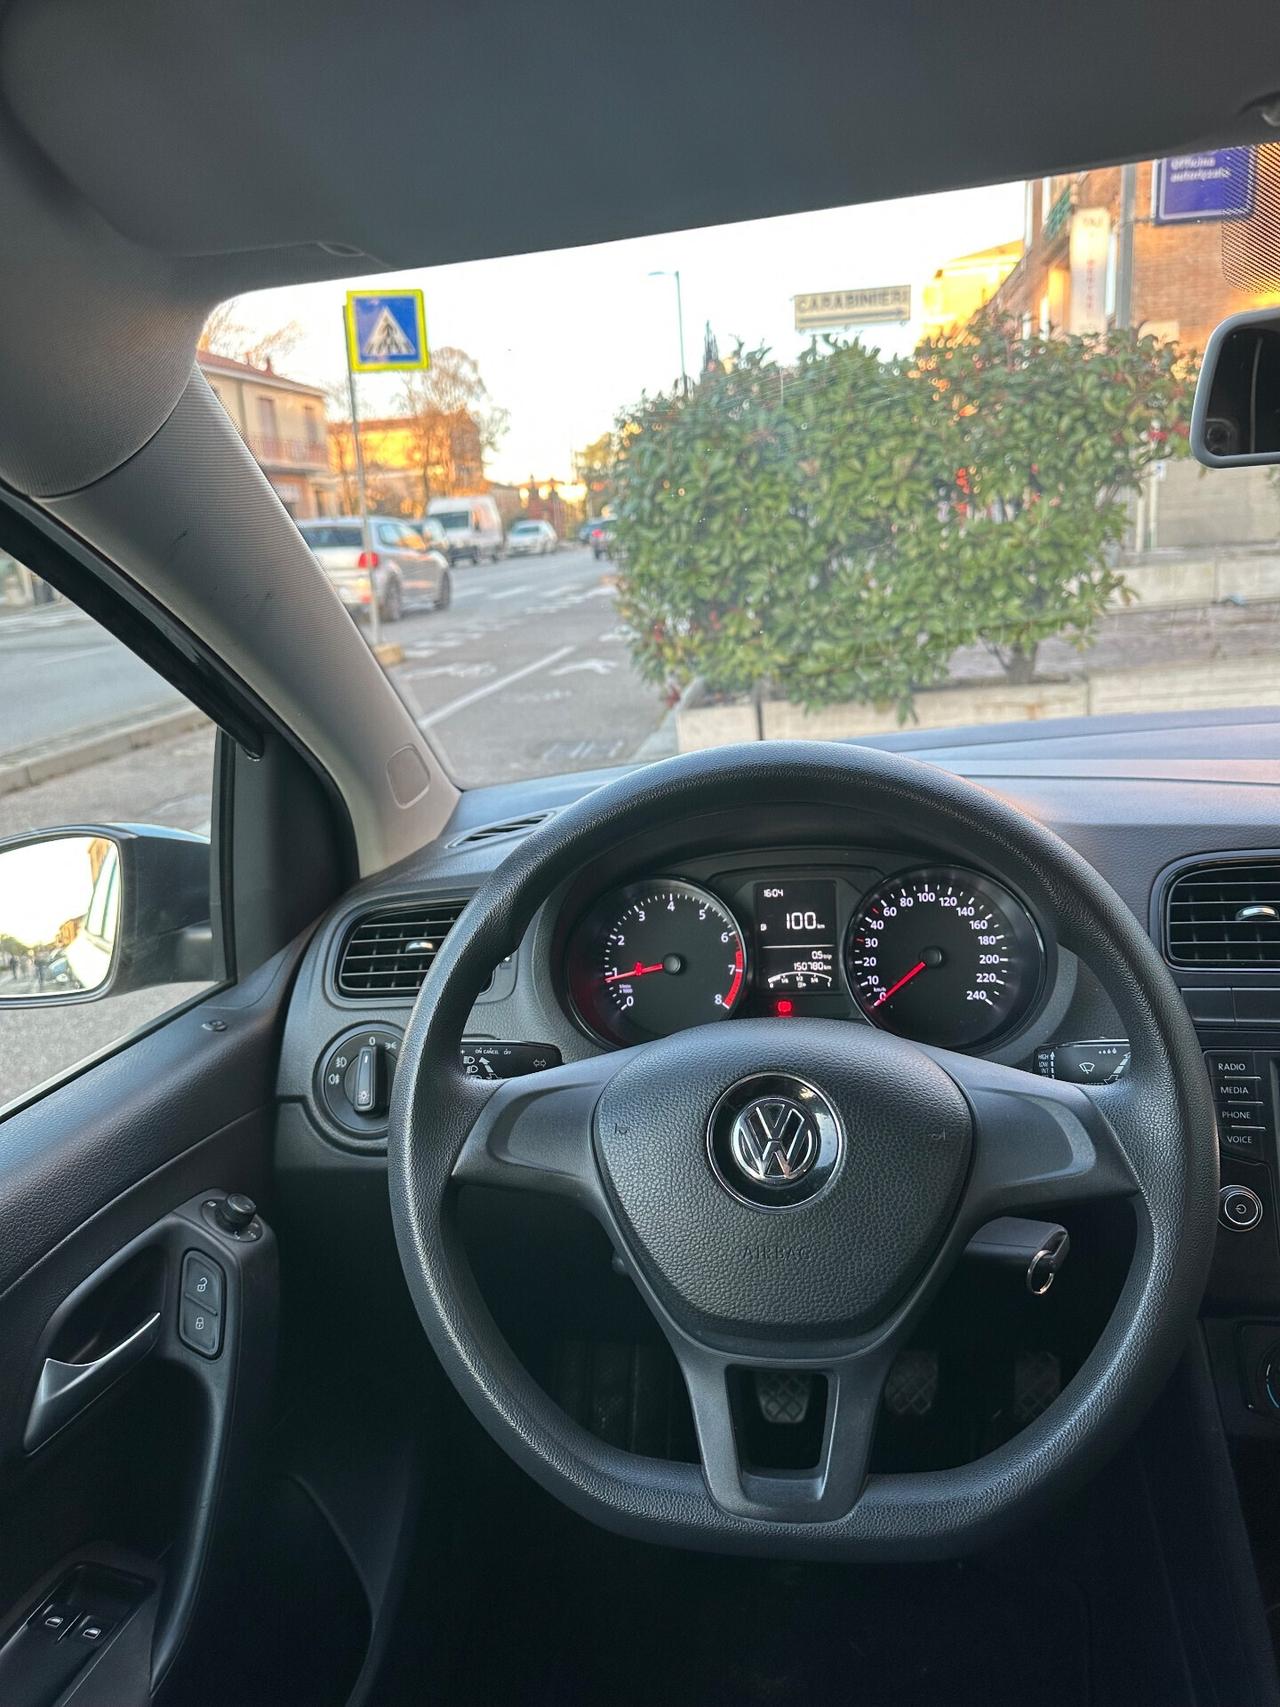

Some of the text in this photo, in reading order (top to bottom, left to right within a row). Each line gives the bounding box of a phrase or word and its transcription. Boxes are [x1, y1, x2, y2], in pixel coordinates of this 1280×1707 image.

[799, 289, 909, 313] CARABINIERI
[900, 897, 913, 907] 80
[917, 892, 935, 902] 100
[939, 897, 957, 907] 120
[667, 901, 676, 912] 4
[883, 906, 897, 917] 60
[956, 906, 975, 916] 140
[638, 912, 646, 921] 3
[699, 909, 706, 920] 5
[786, 911, 817, 930] 100
[870, 920, 884, 930] 40
[969, 920, 988, 930] 160
[617, 935, 625, 946] 2
[720, 932, 729, 943] 6
[865, 937, 878, 948] 30
[978, 935, 996, 945] 180
[863, 957, 877, 967] 20
[979, 954, 999, 964] 200
[728, 964, 736, 975] 7
[794, 961, 824, 971] 150780
[611, 967, 618, 977] 1
[867, 975, 879, 985] 10
[976, 973, 996, 983] 220
[714, 993, 722, 1005] 8
[966, 990, 987, 1000] 240
[626, 995, 634, 1006] 0
[1218, 1063, 1246, 1071] RADIO
[1220, 1086, 1249, 1094] MEDIA
[1222, 1111, 1251, 1119] PHONE
